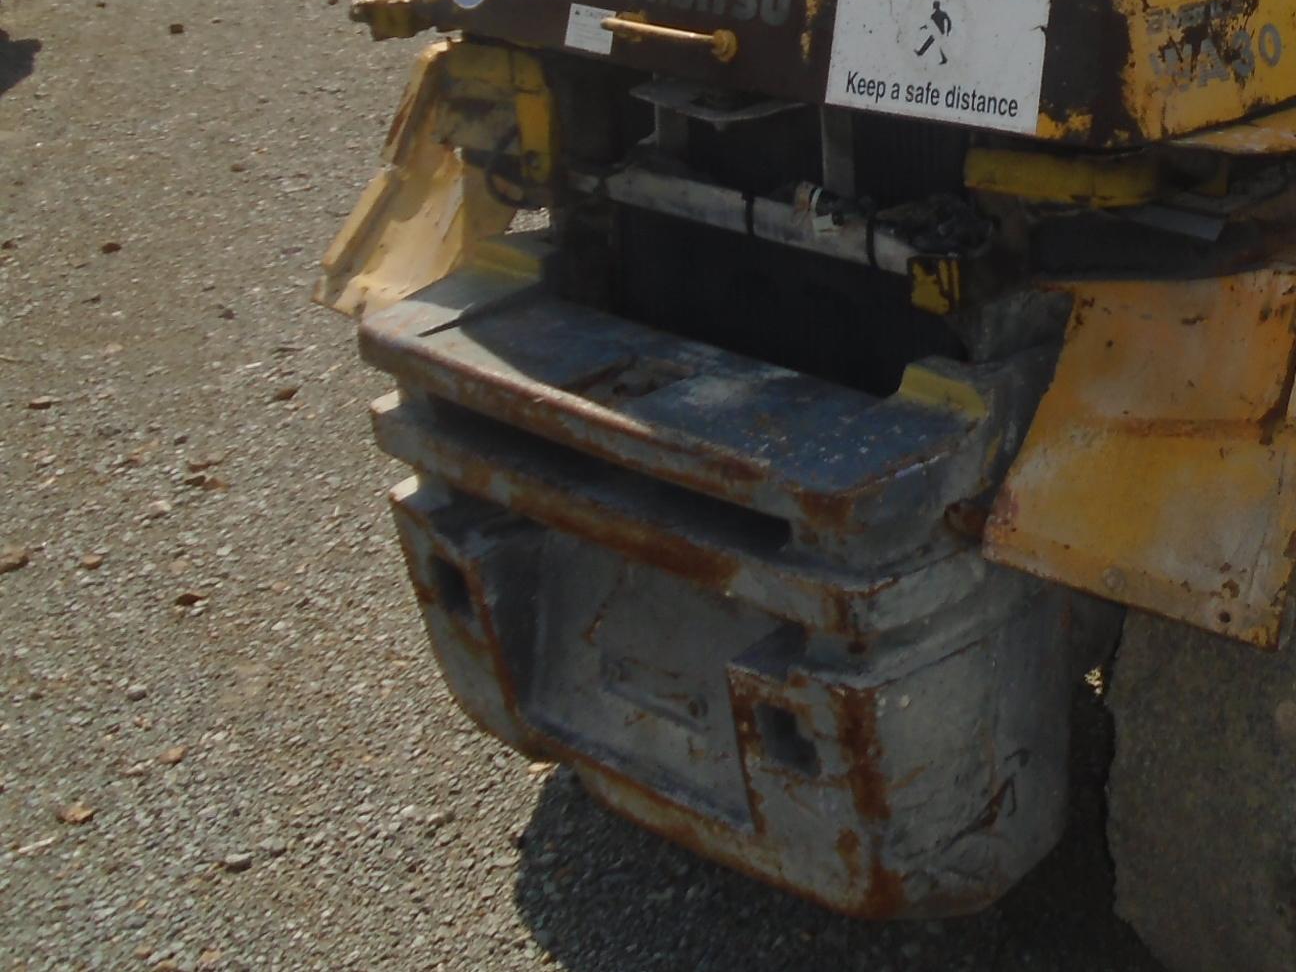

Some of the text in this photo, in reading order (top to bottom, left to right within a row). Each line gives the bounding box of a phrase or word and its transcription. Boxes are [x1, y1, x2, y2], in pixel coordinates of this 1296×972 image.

[845, 70, 1019, 118] Keep a safe distance
